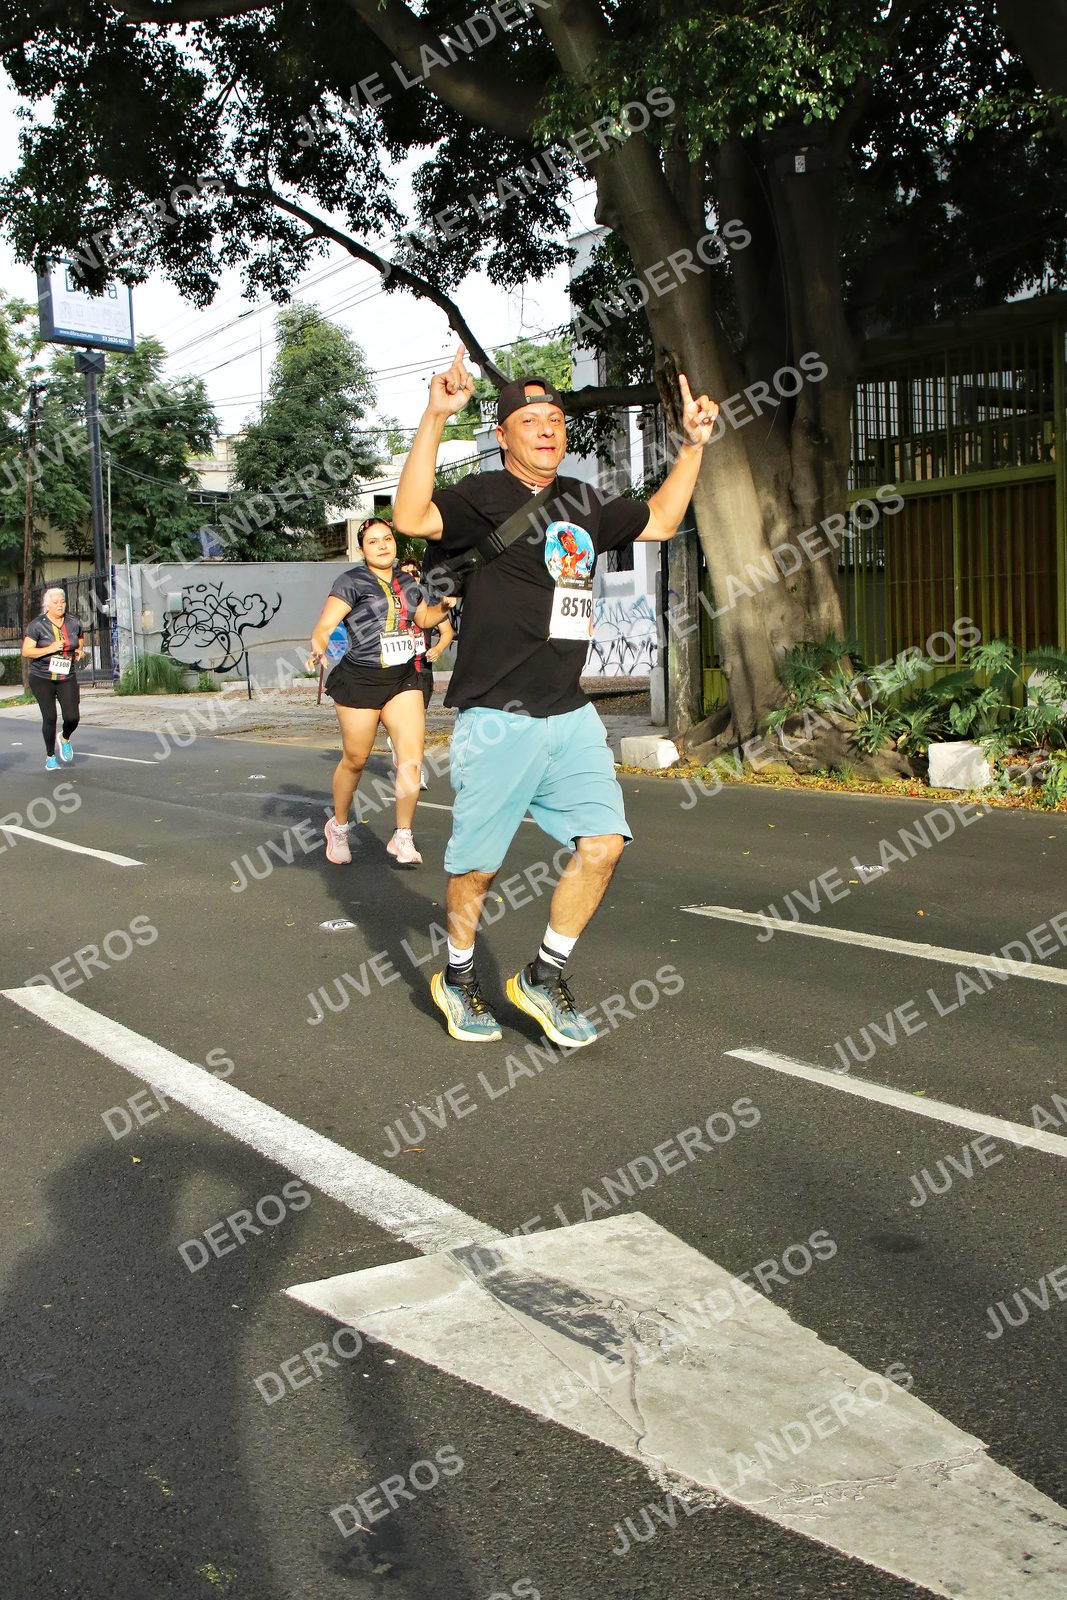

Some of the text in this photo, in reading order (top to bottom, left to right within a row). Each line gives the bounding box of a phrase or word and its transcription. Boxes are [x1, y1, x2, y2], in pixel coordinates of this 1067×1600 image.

[183, 581, 223, 597] TOY
[561, 597, 592, 618] 8518
[384, 639, 413, 653] 11178
